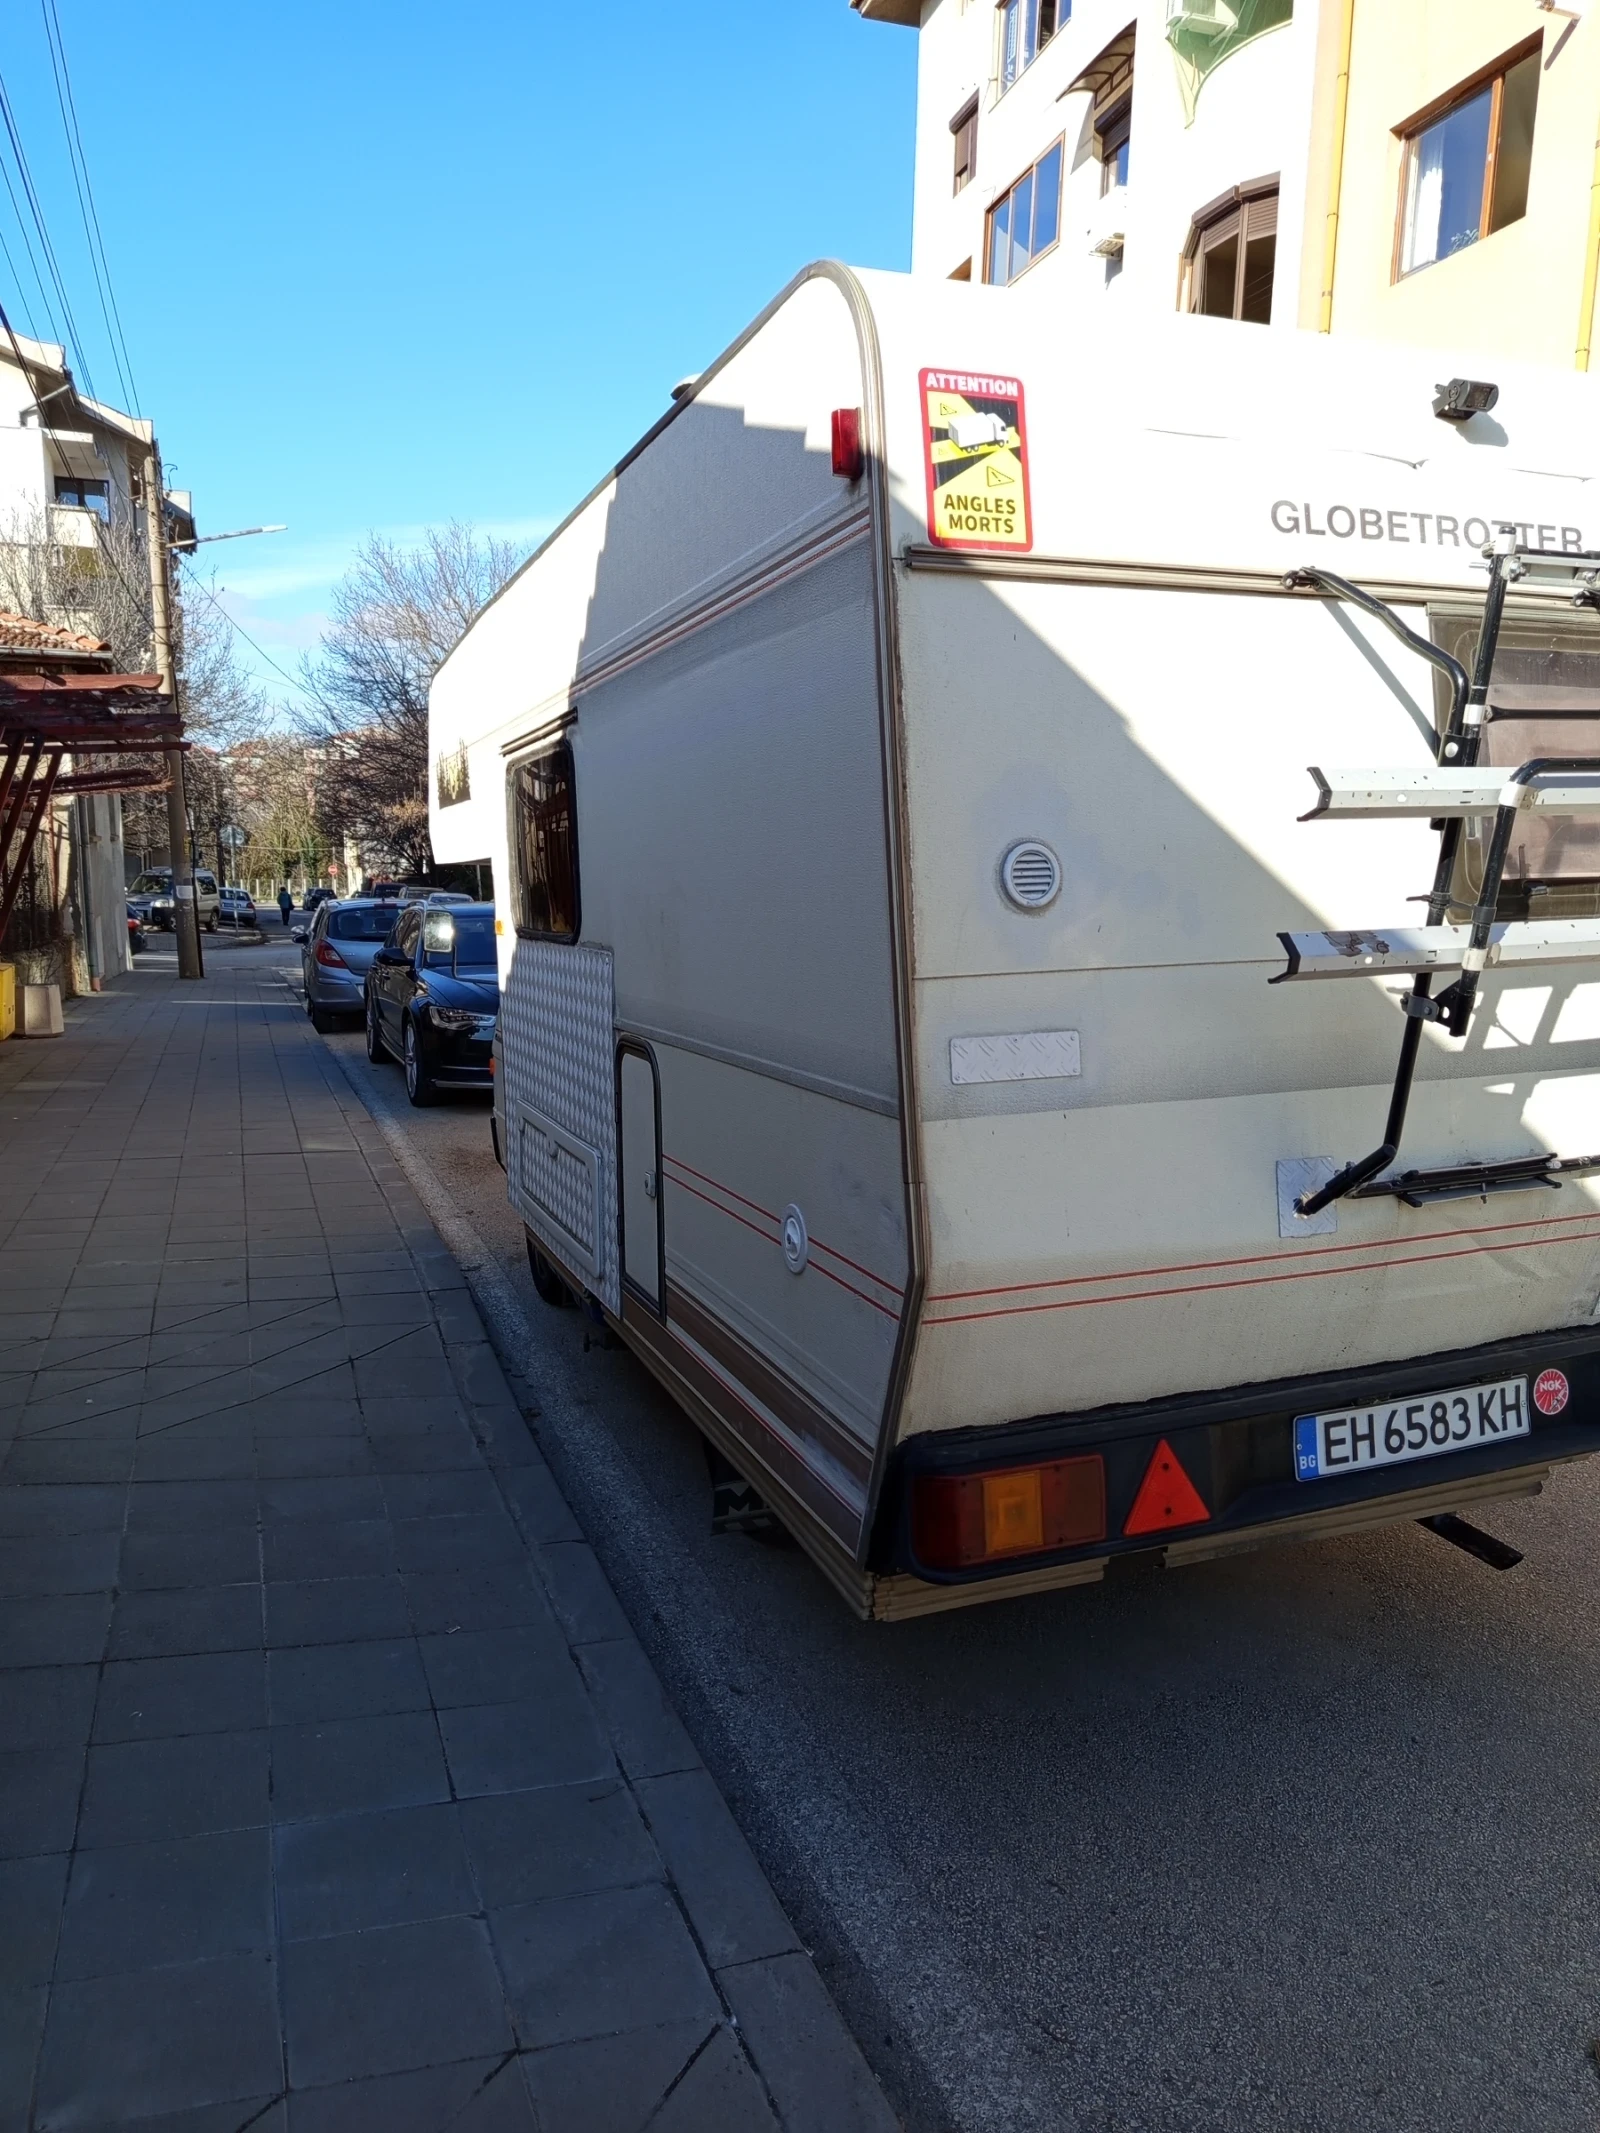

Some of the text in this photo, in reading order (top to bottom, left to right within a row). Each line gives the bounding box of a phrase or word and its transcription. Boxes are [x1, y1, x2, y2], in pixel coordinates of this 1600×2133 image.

[926, 372, 1018, 397] ATTENTION
[944, 494, 1016, 515] ANGLES
[949, 514, 1014, 534] MORTS
[1539, 1378, 1562, 1392] NGK
[1299, 1454, 1316, 1470] BG
